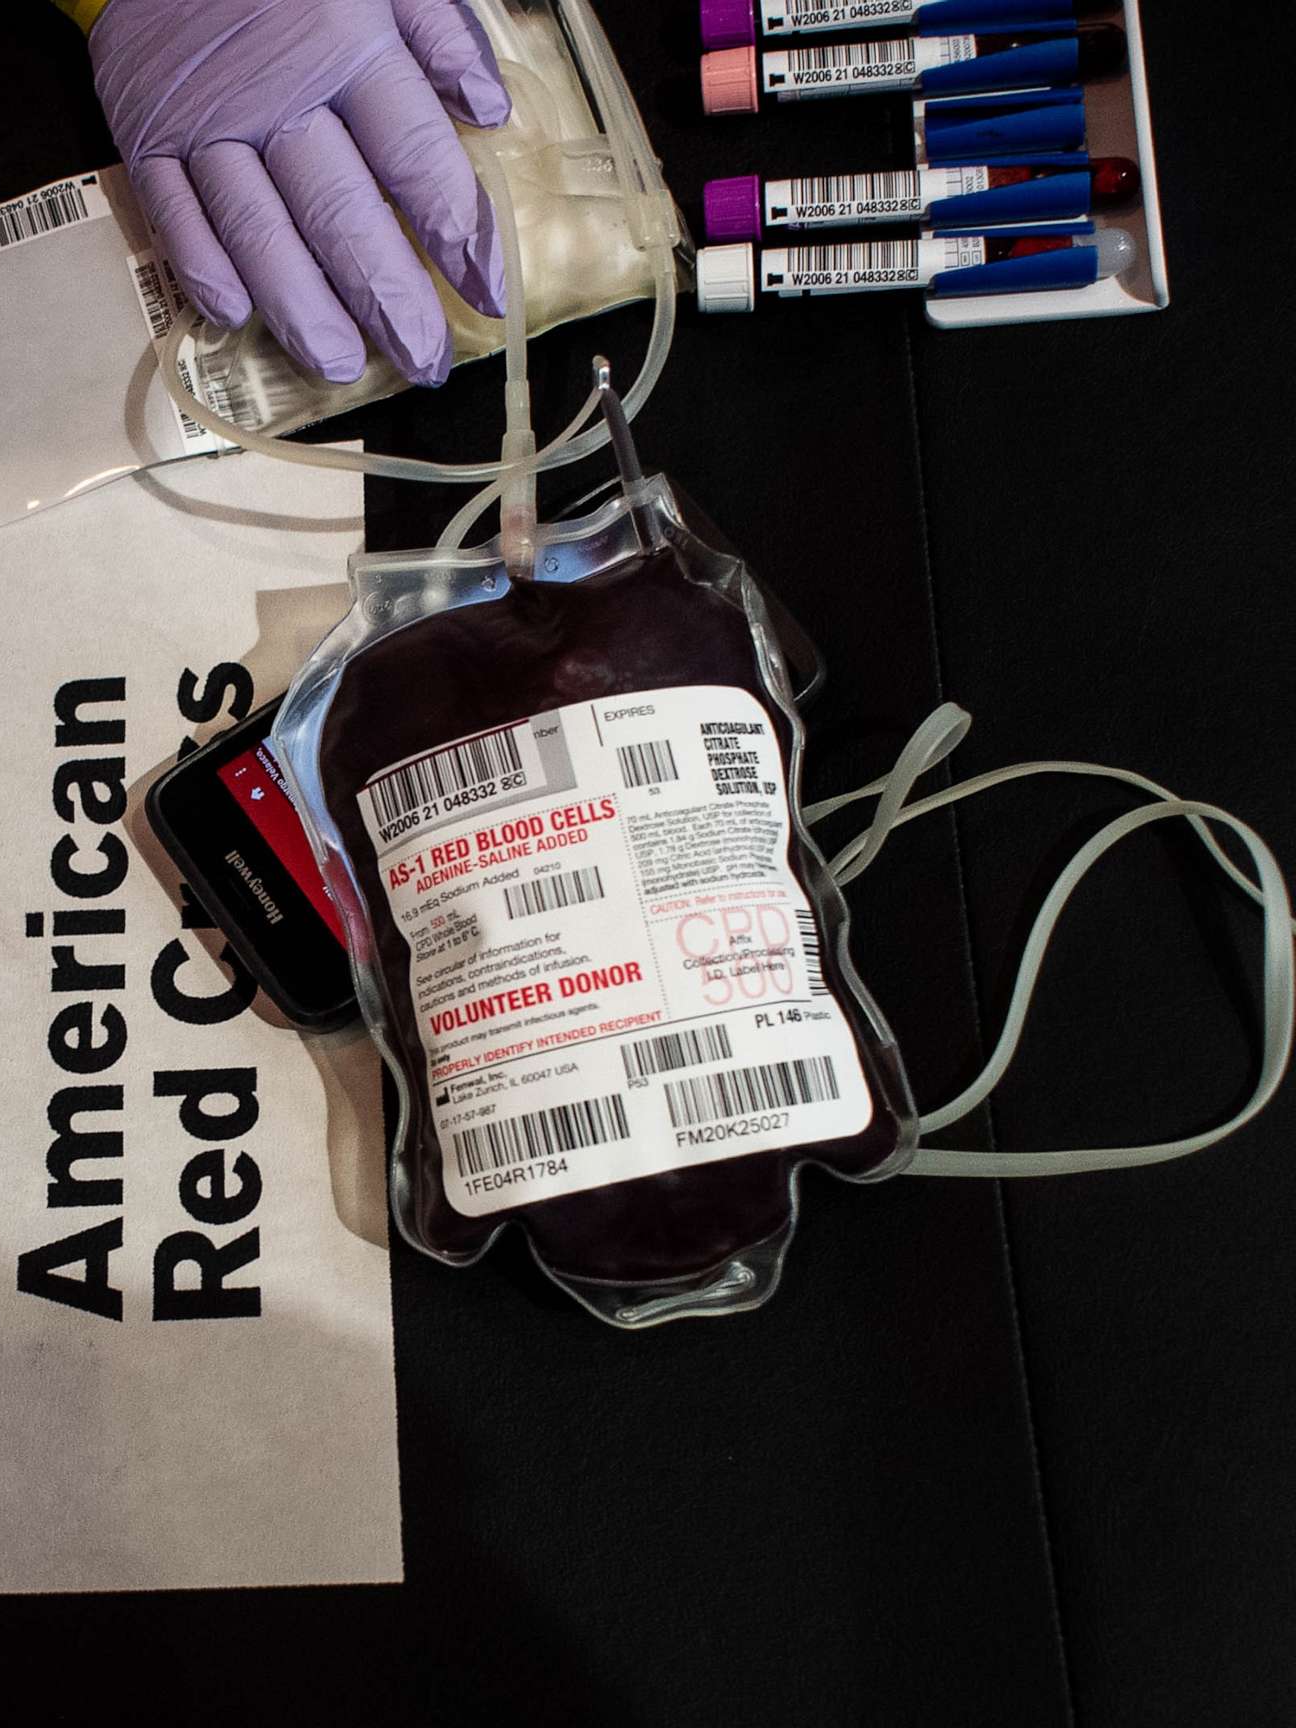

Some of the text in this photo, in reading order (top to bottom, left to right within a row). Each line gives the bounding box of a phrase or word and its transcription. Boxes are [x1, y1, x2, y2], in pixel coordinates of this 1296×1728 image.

[791, 11, 830, 27] W2006
[833, 8, 846, 21] 21
[793, 69, 832, 84] W2006
[835, 67, 848, 80] 21
[26, 194, 40, 207] 21
[795, 203, 836, 218] W2006
[838, 204, 852, 216] 21
[792, 272, 832, 286] W2006
[835, 272, 849, 284] 21
[604, 705, 655, 722] EXPIRES
[700, 722, 765, 736] ANTICOAGULANT
[703, 737, 741, 751] CITRATE
[707, 752, 760, 767] PHOSPHATE
[711, 766, 758, 782] DEXTROSE
[715, 782, 777, 797] SOLUTION, USP
[378, 811, 420, 844] W2006
[422, 804, 440, 821] 21
[443, 782, 497, 812] 048332
[388, 798, 616, 890] AS-1 RED BLOOD CELLS
[414, 828, 588, 894] ADENINE-SALINE ADDED
[224, 850, 284, 925] Honeywell
[440, 881, 480, 903] Sodium
[482, 868, 520, 887] Added
[415, 913, 478, 951] CPD Whole Blood
[675, 903, 790, 960] CPD
[415, 947, 437, 963] Store
[416, 931, 561, 987] See circular of information for
[682, 947, 795, 970] Collection/Processing
[729, 962, 761, 977] Label
[762, 962, 785, 972] Here
[419, 955, 592, 1014] cautions and methods of infusion.
[701, 950, 794, 1006] 500
[16, 676, 130, 1322] American
[430, 961, 643, 1036] VOLUNTEER DONOR
[488, 1021, 522, 1037] transmit
[523, 1010, 566, 1027] infectious
[567, 1003, 600, 1017] agents.
[755, 1008, 831, 1029] PL 146 Plastic
[432, 1010, 663, 1079] PROPERLY IDENTIFY INTENDED RECIPIENT
[450, 1071, 508, 1093] Fenwal, Inc.
[452, 1090, 473, 1104] Lake
[521, 1068, 552, 1085] 60047
[555, 1062, 579, 1076] USA
[676, 1113, 791, 1148] FM20K25027
[151, 1066, 262, 1321] Red
[464, 1158, 569, 1196] 1FE04R1784
